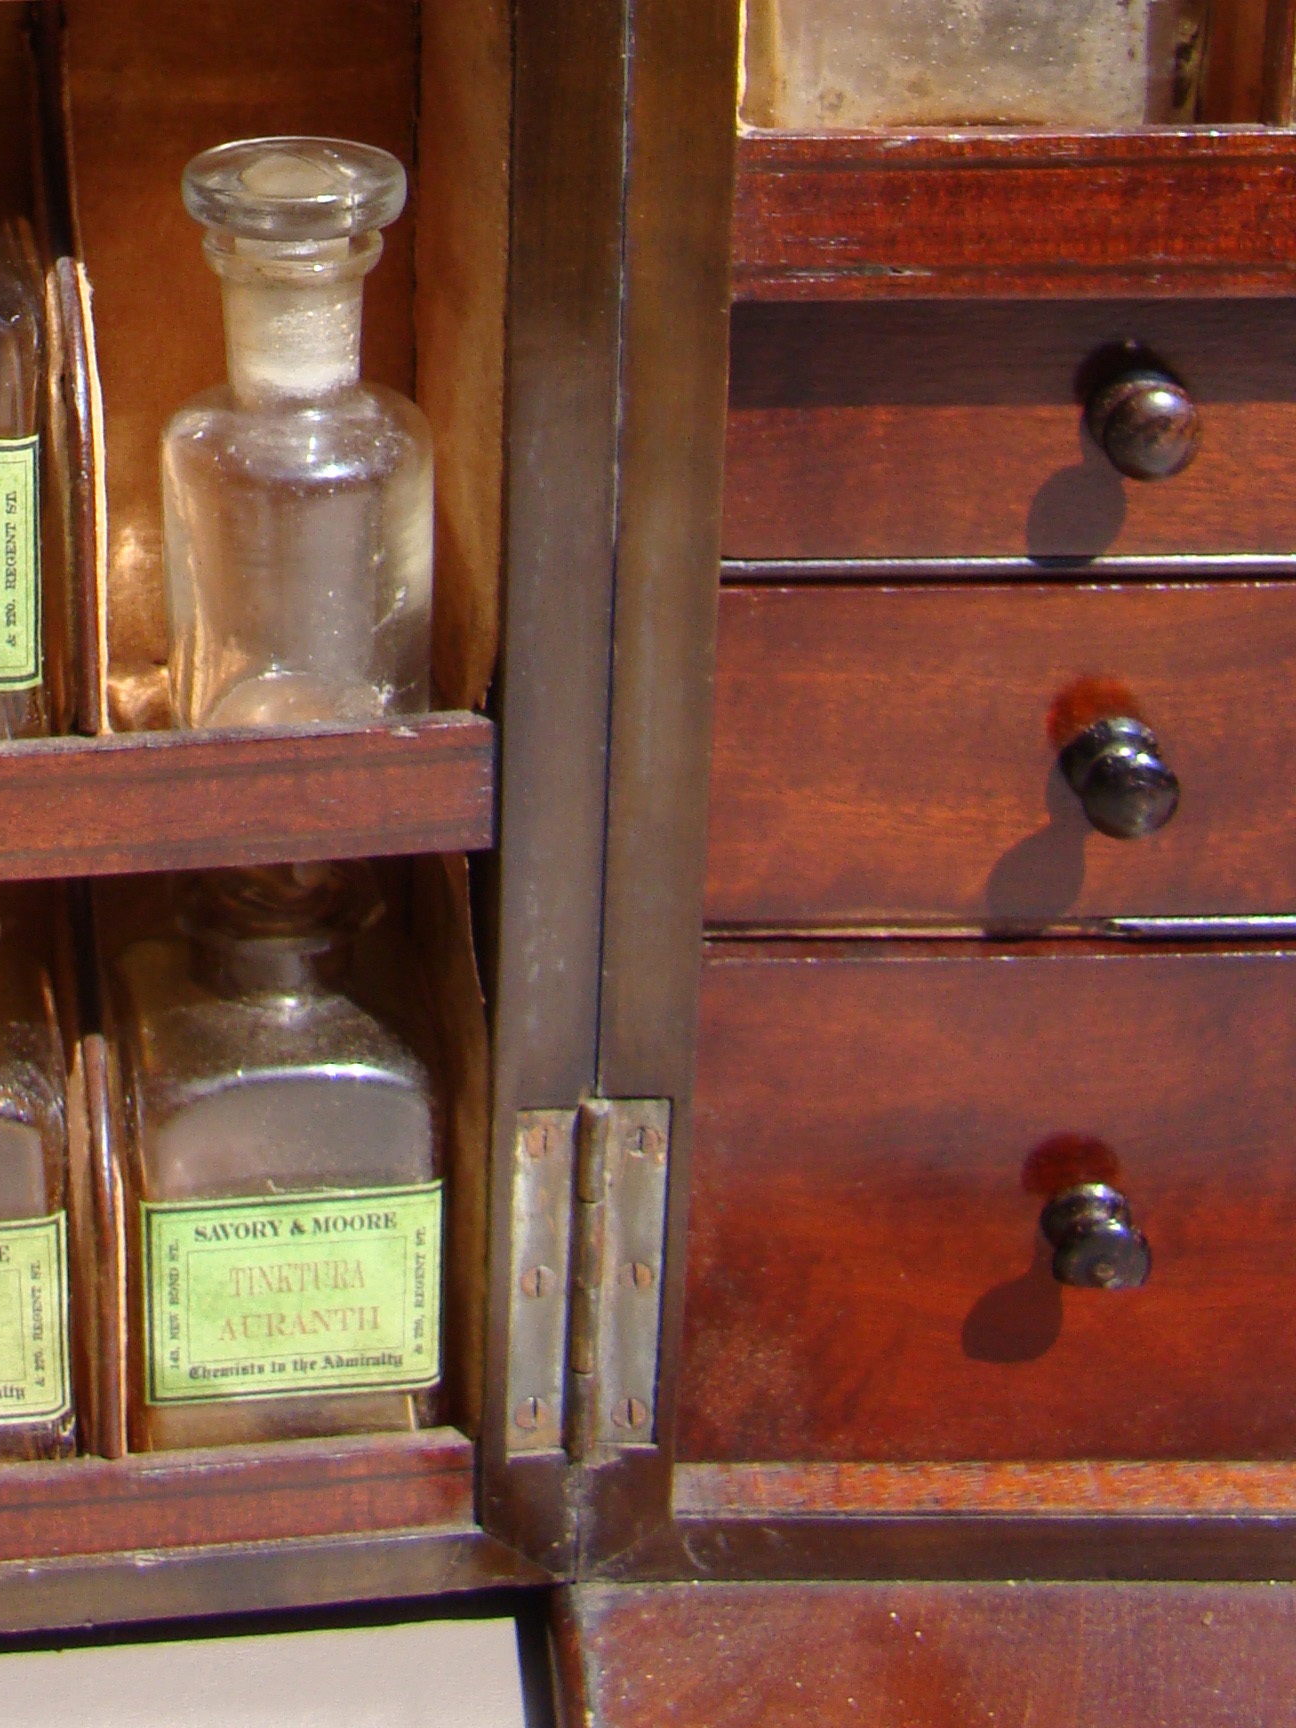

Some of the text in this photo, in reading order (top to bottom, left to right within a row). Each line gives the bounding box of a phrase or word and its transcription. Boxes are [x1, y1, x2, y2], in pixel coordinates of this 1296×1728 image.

[6, 491, 17, 514] ST.
[5, 522, 17, 590] REGENT
[6, 635, 17, 647] &
[194, 1212, 397, 1243] SAVORY & MOORE
[168, 1267, 180, 1306] BOND
[415, 1252, 426, 1308] REGENT
[32, 1285, 44, 1341] REGENT
[169, 1312, 180, 1341] NEW
[189, 1351, 403, 1380] Chemists to the Admiralty
